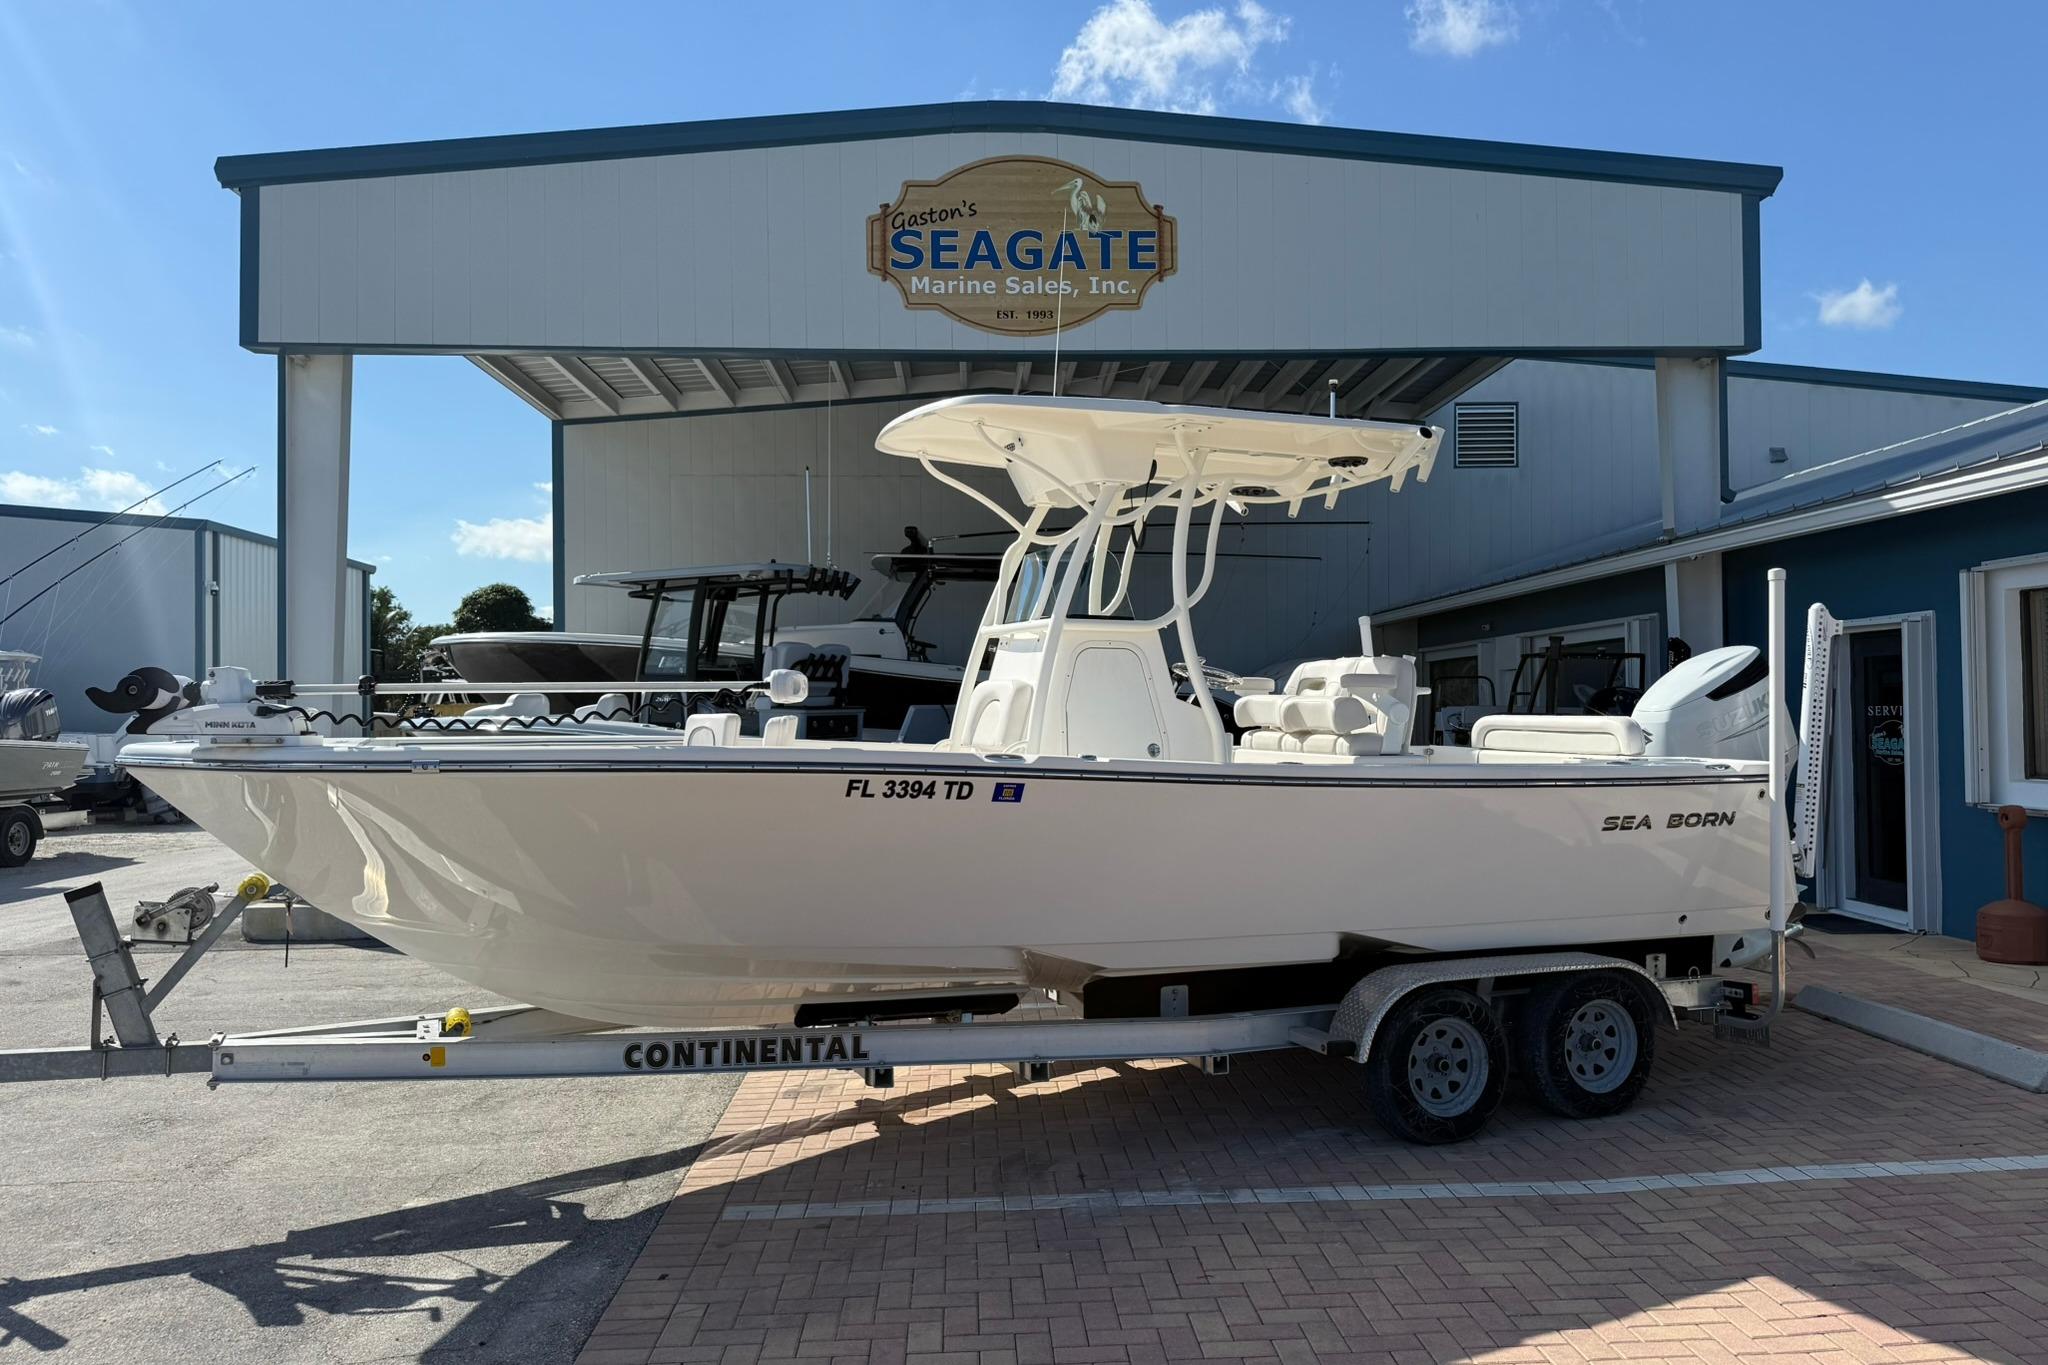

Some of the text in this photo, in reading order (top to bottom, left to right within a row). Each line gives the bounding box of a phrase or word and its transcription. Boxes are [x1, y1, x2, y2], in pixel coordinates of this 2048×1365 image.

[891, 200, 978, 230] Gaston's
[889, 230, 1157, 271] SEAGATE
[911, 276, 1137, 298] Marine Sales, Inc.
[996, 310, 1054, 320] EST. 1993
[204, 721, 256, 729] MINN KOTA
[845, 779, 974, 800] FL 3394 TD
[1601, 810, 1737, 832] SEA BORN
[623, 1034, 870, 1070] CONTINENTAL
